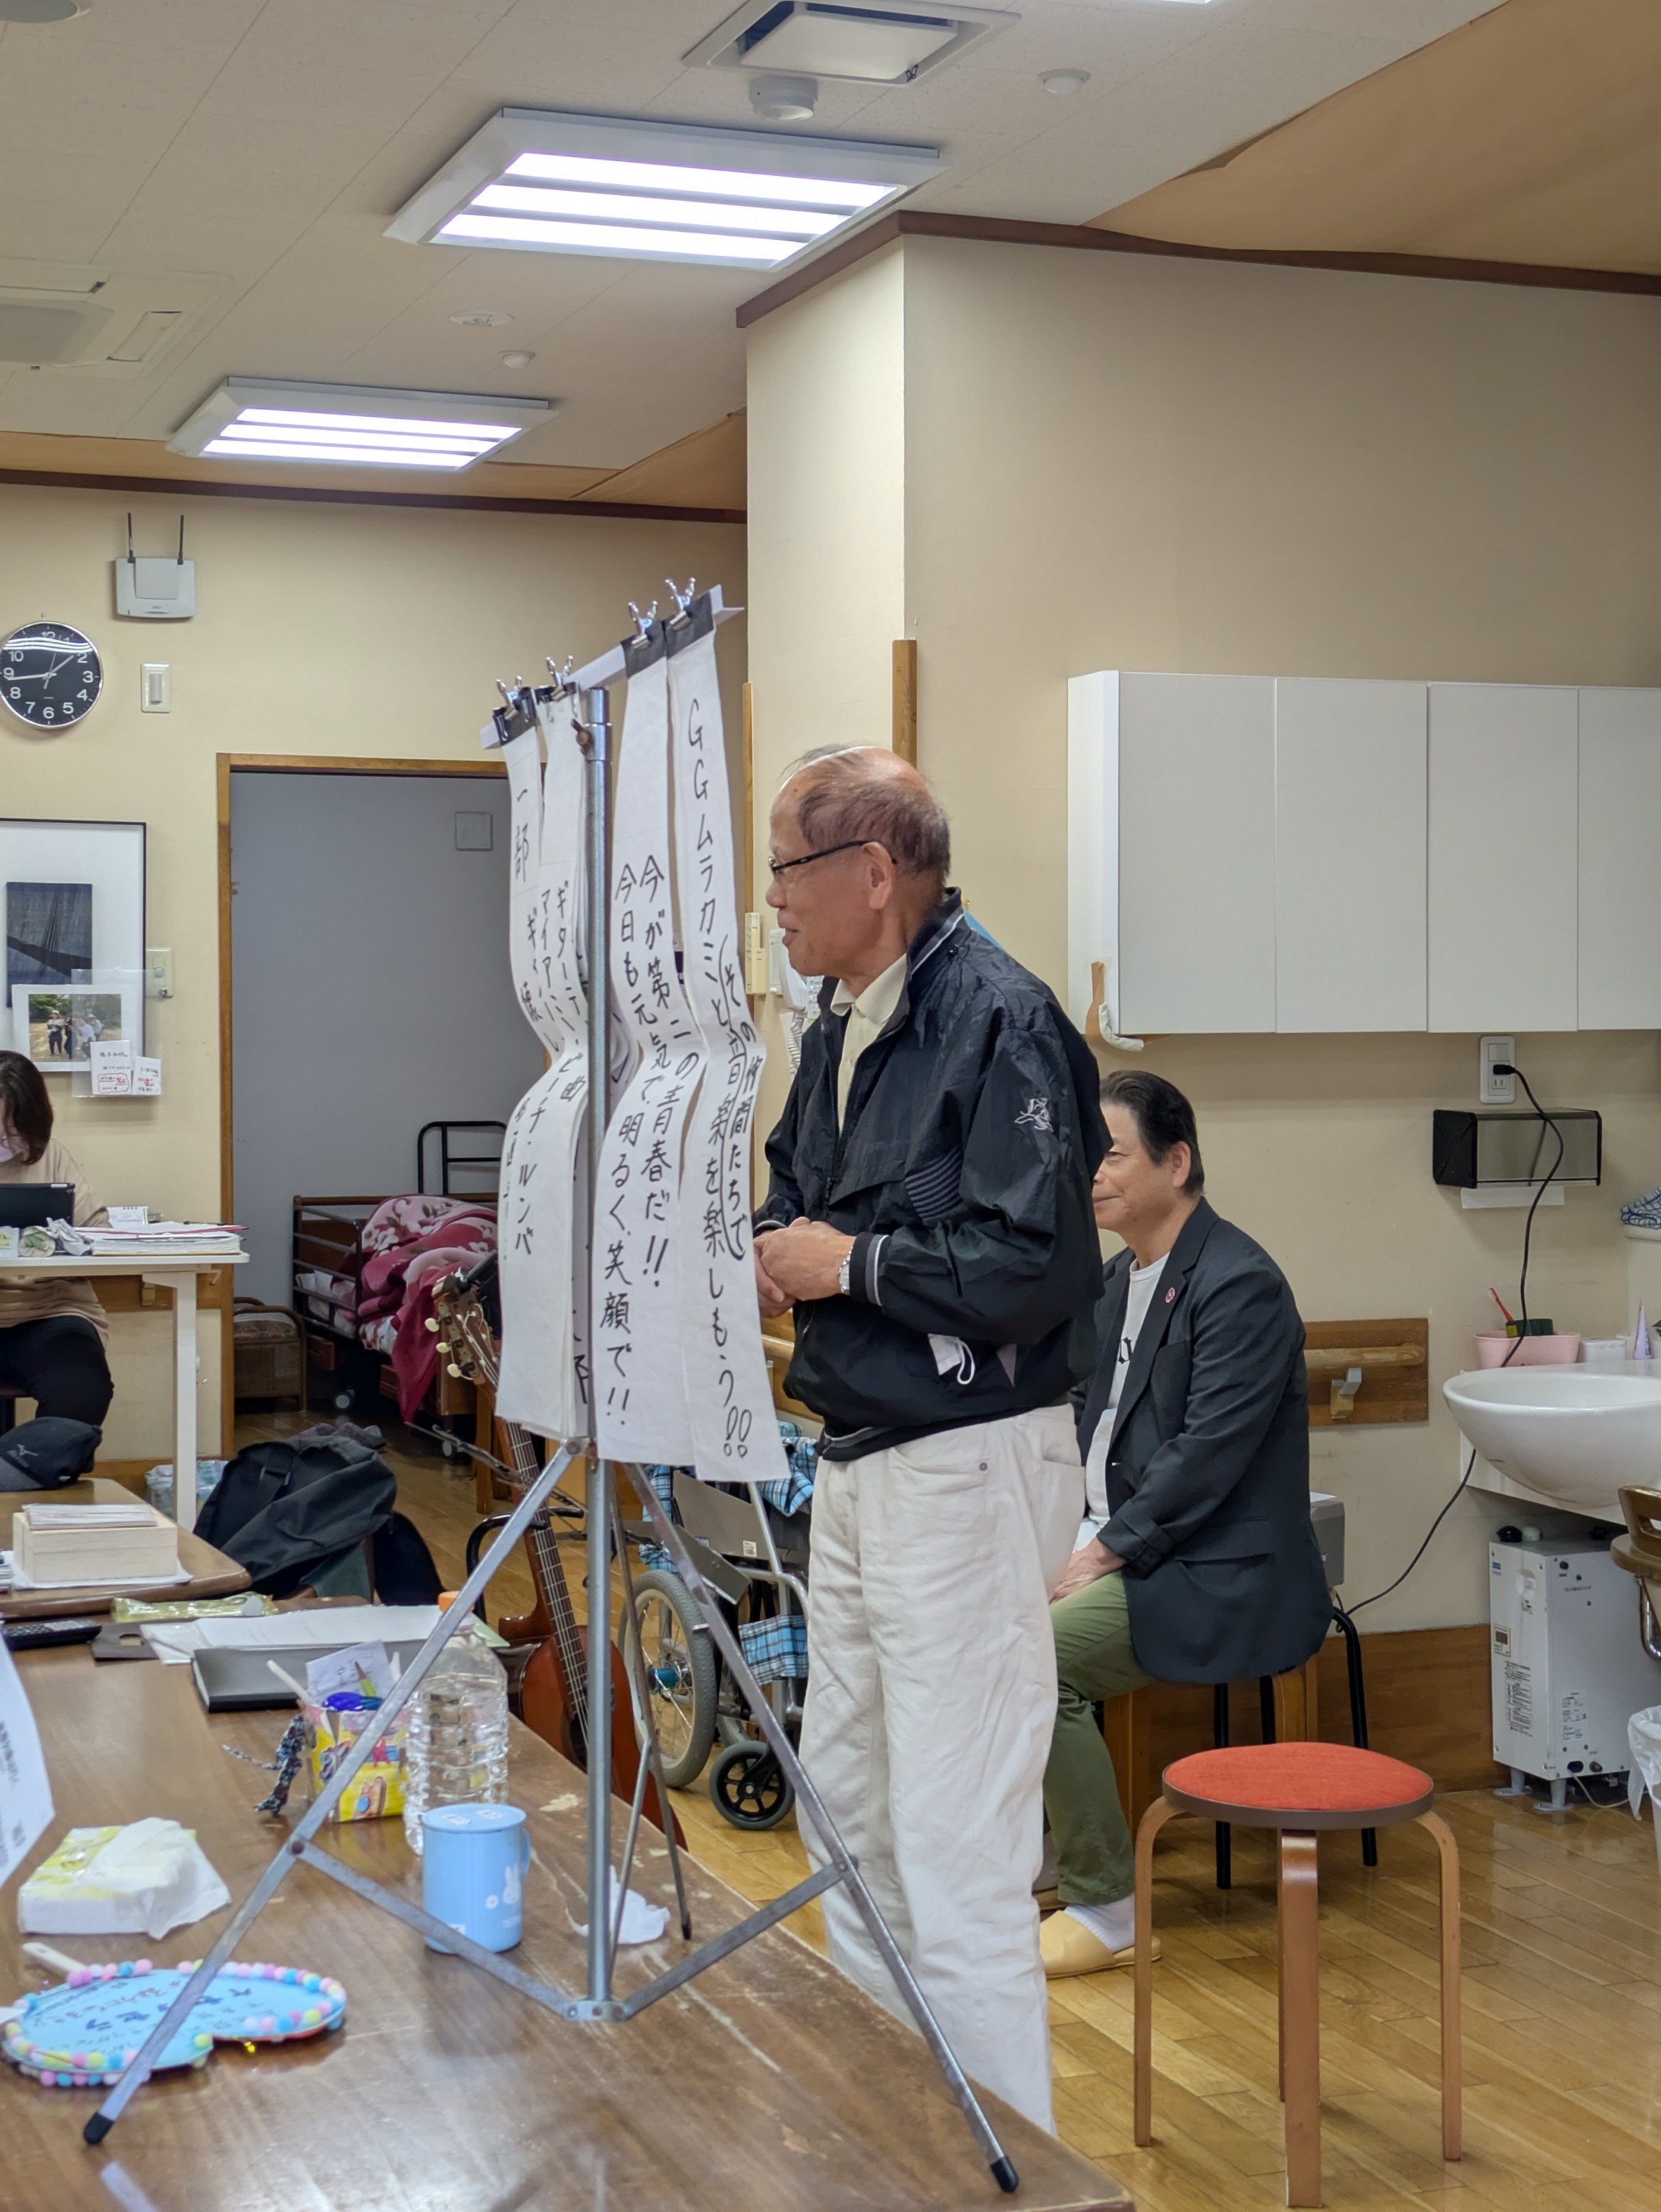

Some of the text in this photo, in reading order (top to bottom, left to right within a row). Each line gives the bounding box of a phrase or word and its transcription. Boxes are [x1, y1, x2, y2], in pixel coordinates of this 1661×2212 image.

[8, 650, 23, 662] 10
[77, 653, 88, 663] 2
[82, 671, 94, 683] 3
[10, 687, 21, 699] 8
[76, 688, 87, 701] 4
[26, 702, 36, 714] 7
[43, 707, 55, 719] 6
[62, 702, 74, 714] 5
